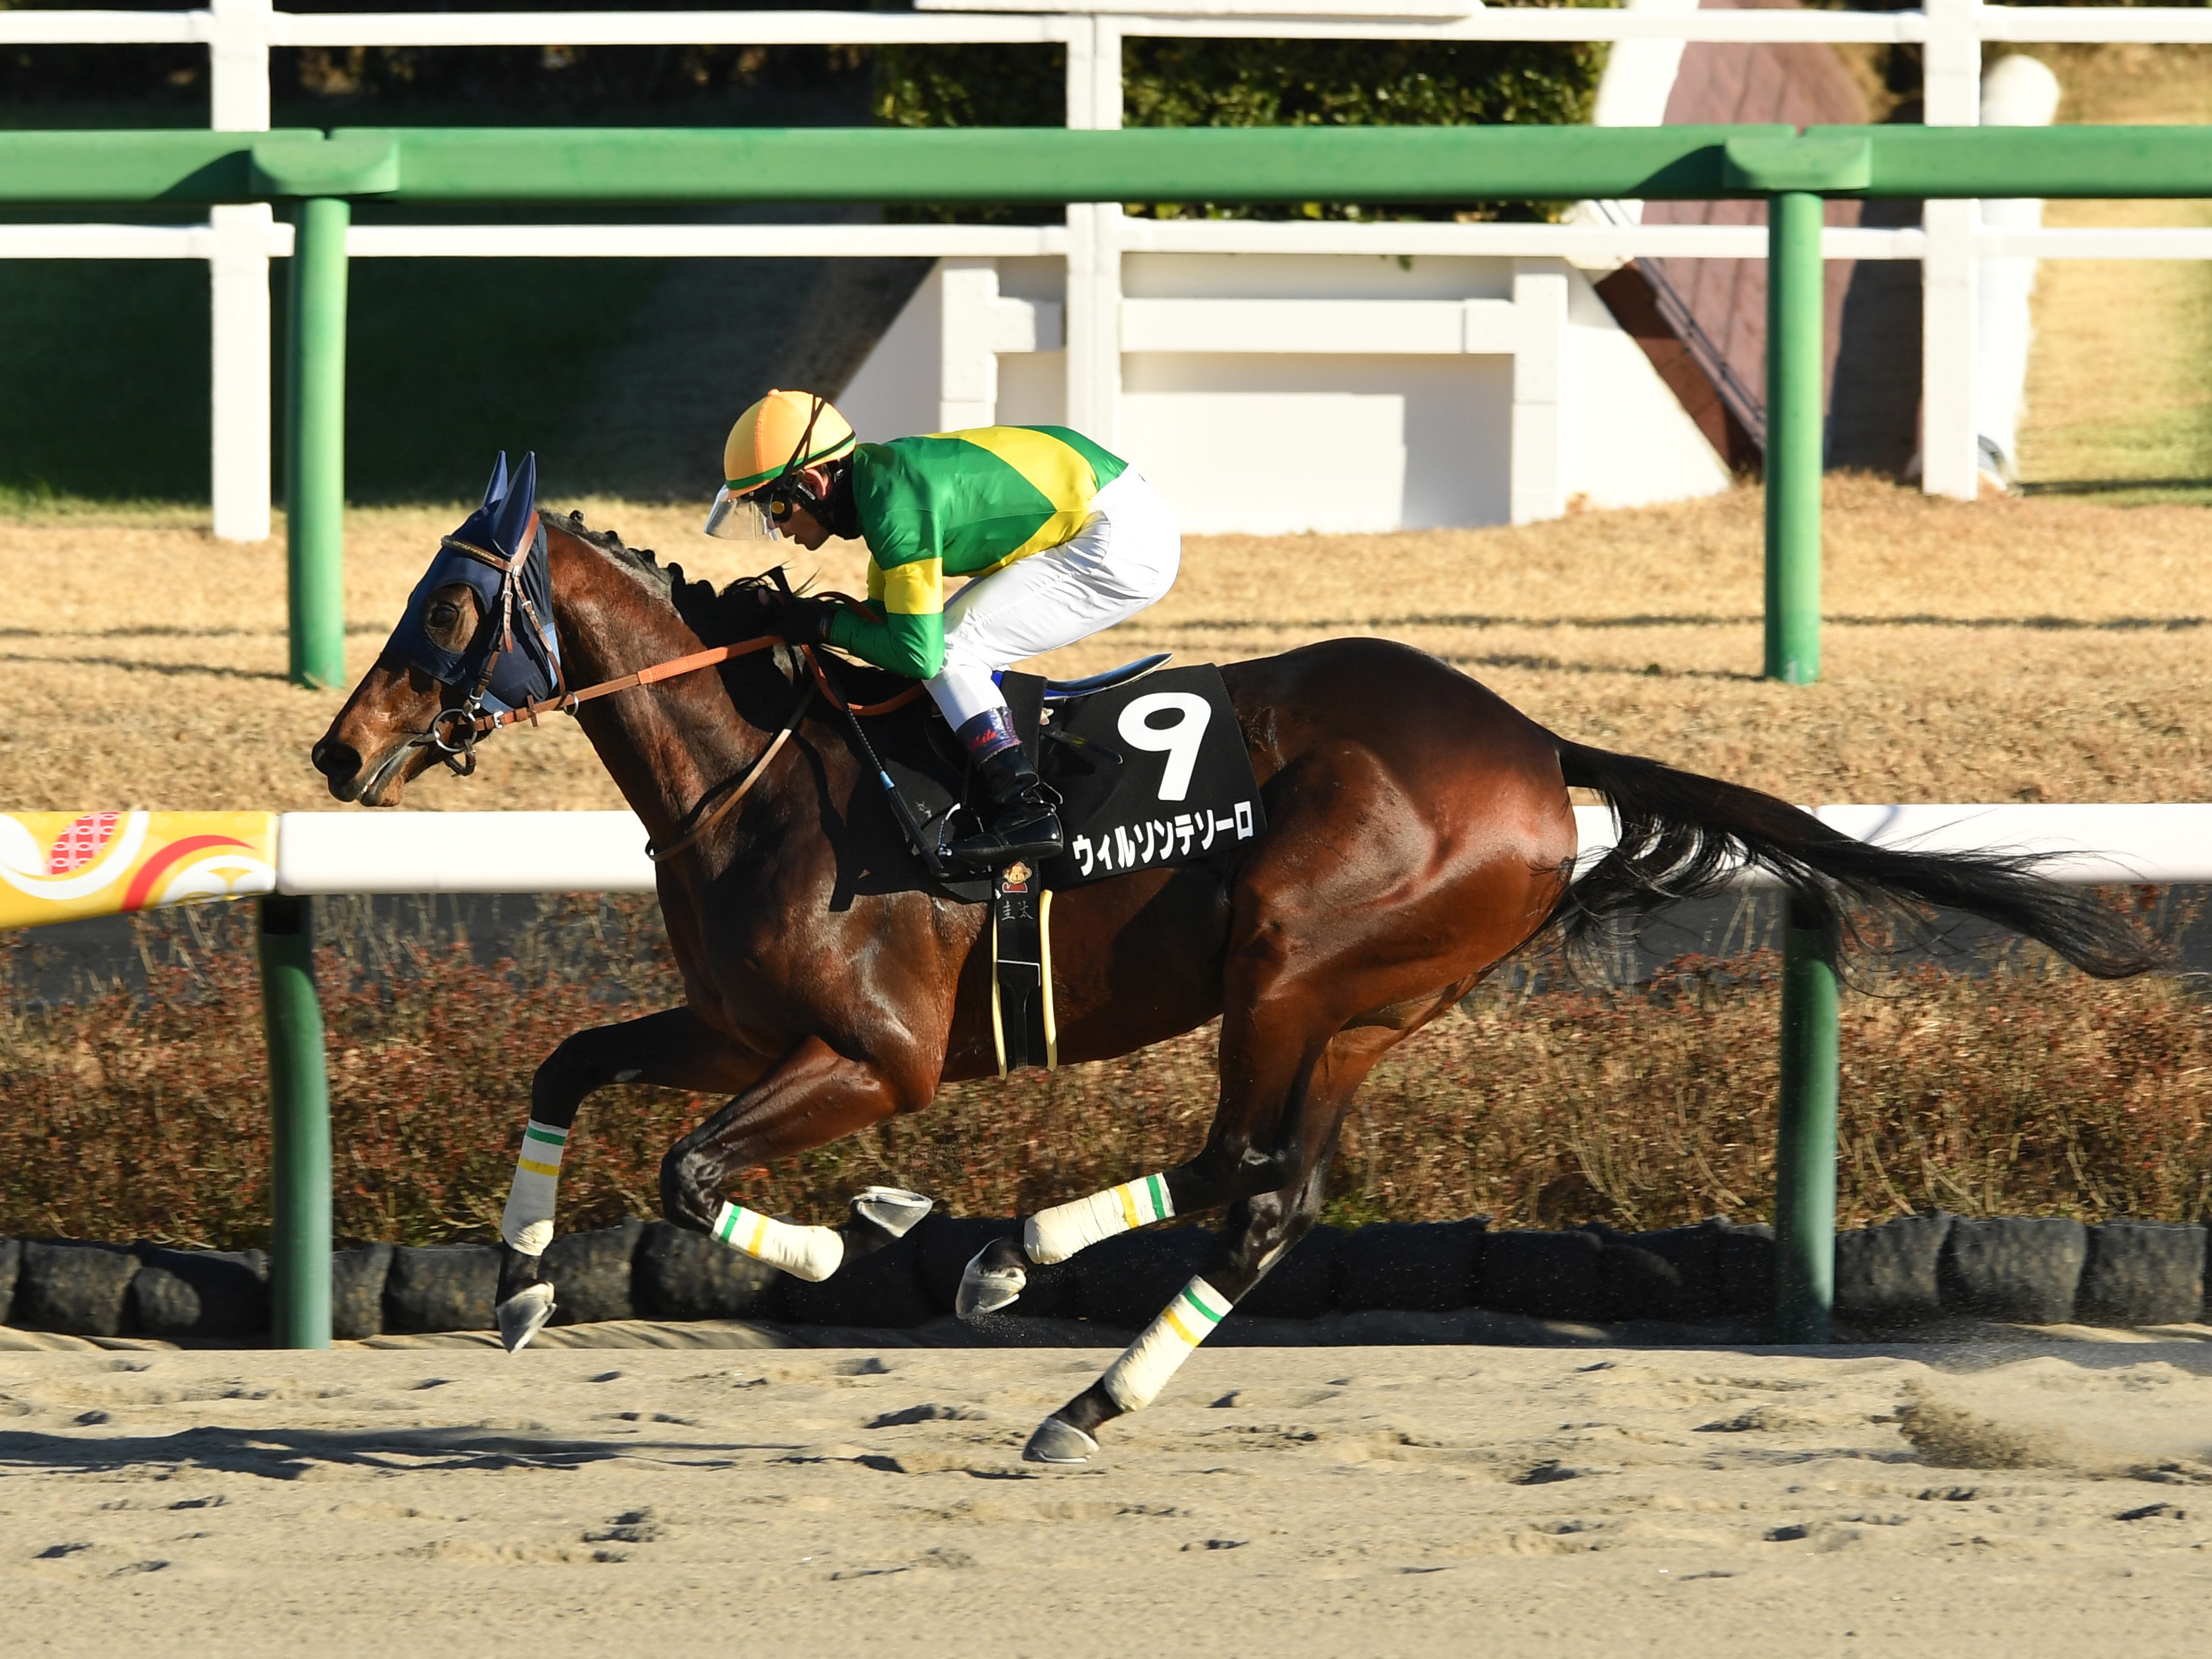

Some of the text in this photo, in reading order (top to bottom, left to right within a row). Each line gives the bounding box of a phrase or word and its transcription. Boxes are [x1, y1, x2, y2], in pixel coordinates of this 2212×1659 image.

[1118, 692, 1212, 801] 9
[1072, 801, 1254, 876] ウィルソンテソーロ
